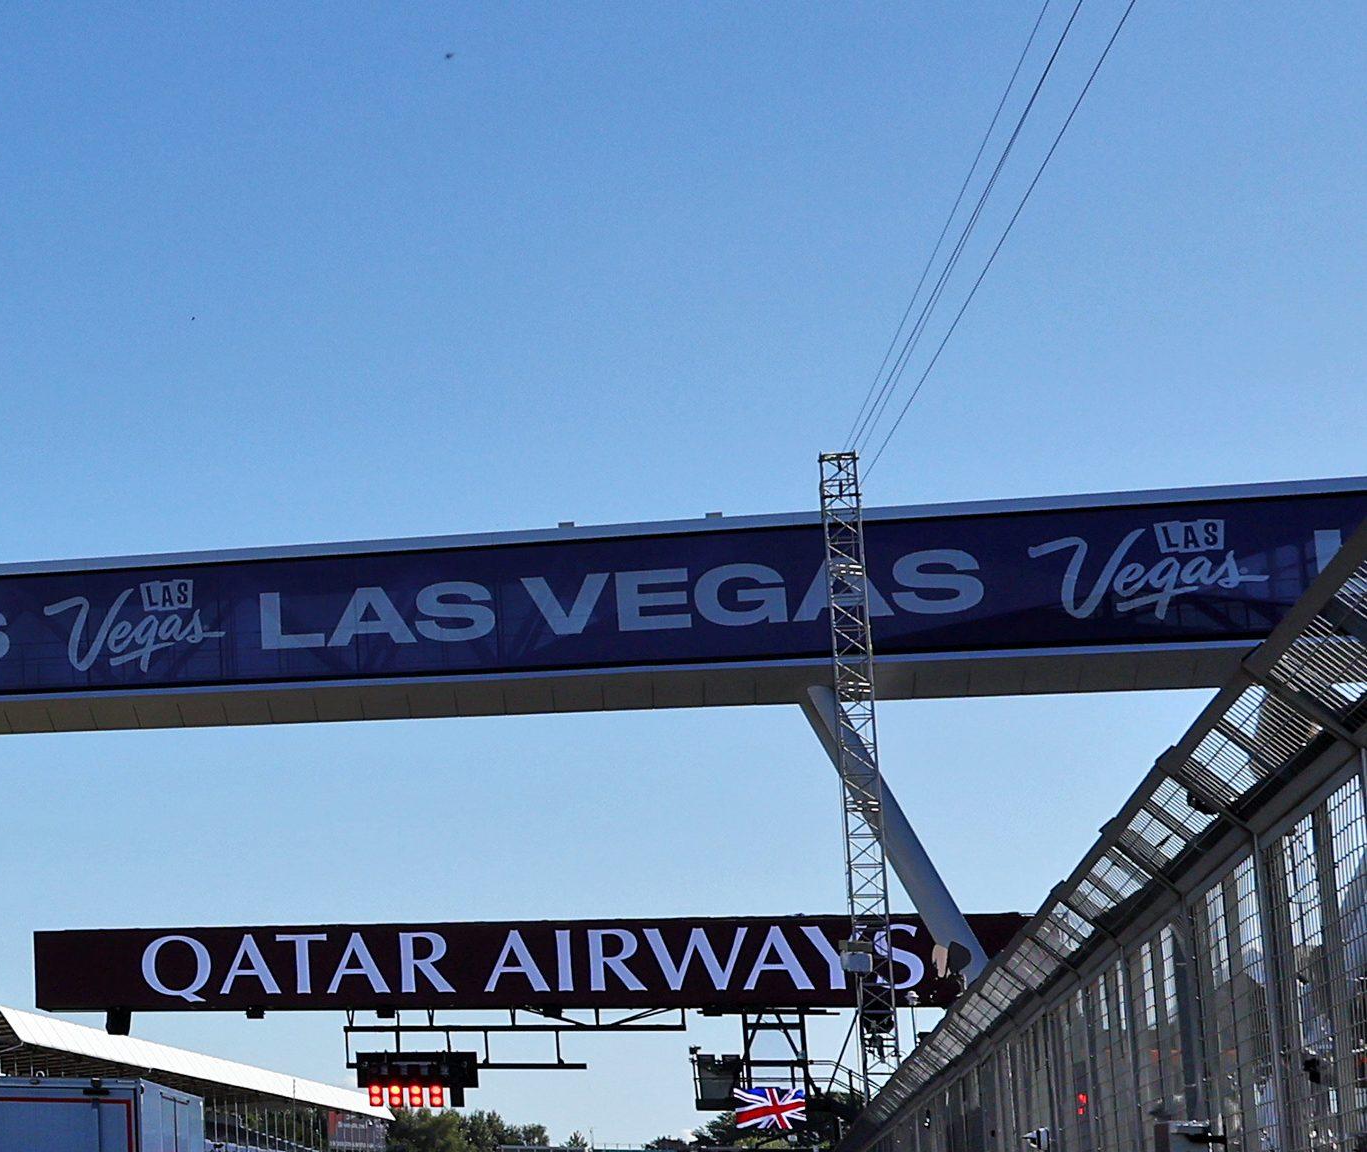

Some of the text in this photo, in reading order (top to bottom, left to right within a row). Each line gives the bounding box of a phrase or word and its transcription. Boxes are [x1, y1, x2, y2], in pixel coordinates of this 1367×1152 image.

[1028, 527, 1270, 620] Vegas
[1155, 519, 1225, 554] LAS
[44, 587, 226, 672] Vegas
[139, 578, 194, 611] LAS
[260, 549, 984, 650] LAS VEGAS
[141, 923, 925, 1002] QATAR AIRWAYS
